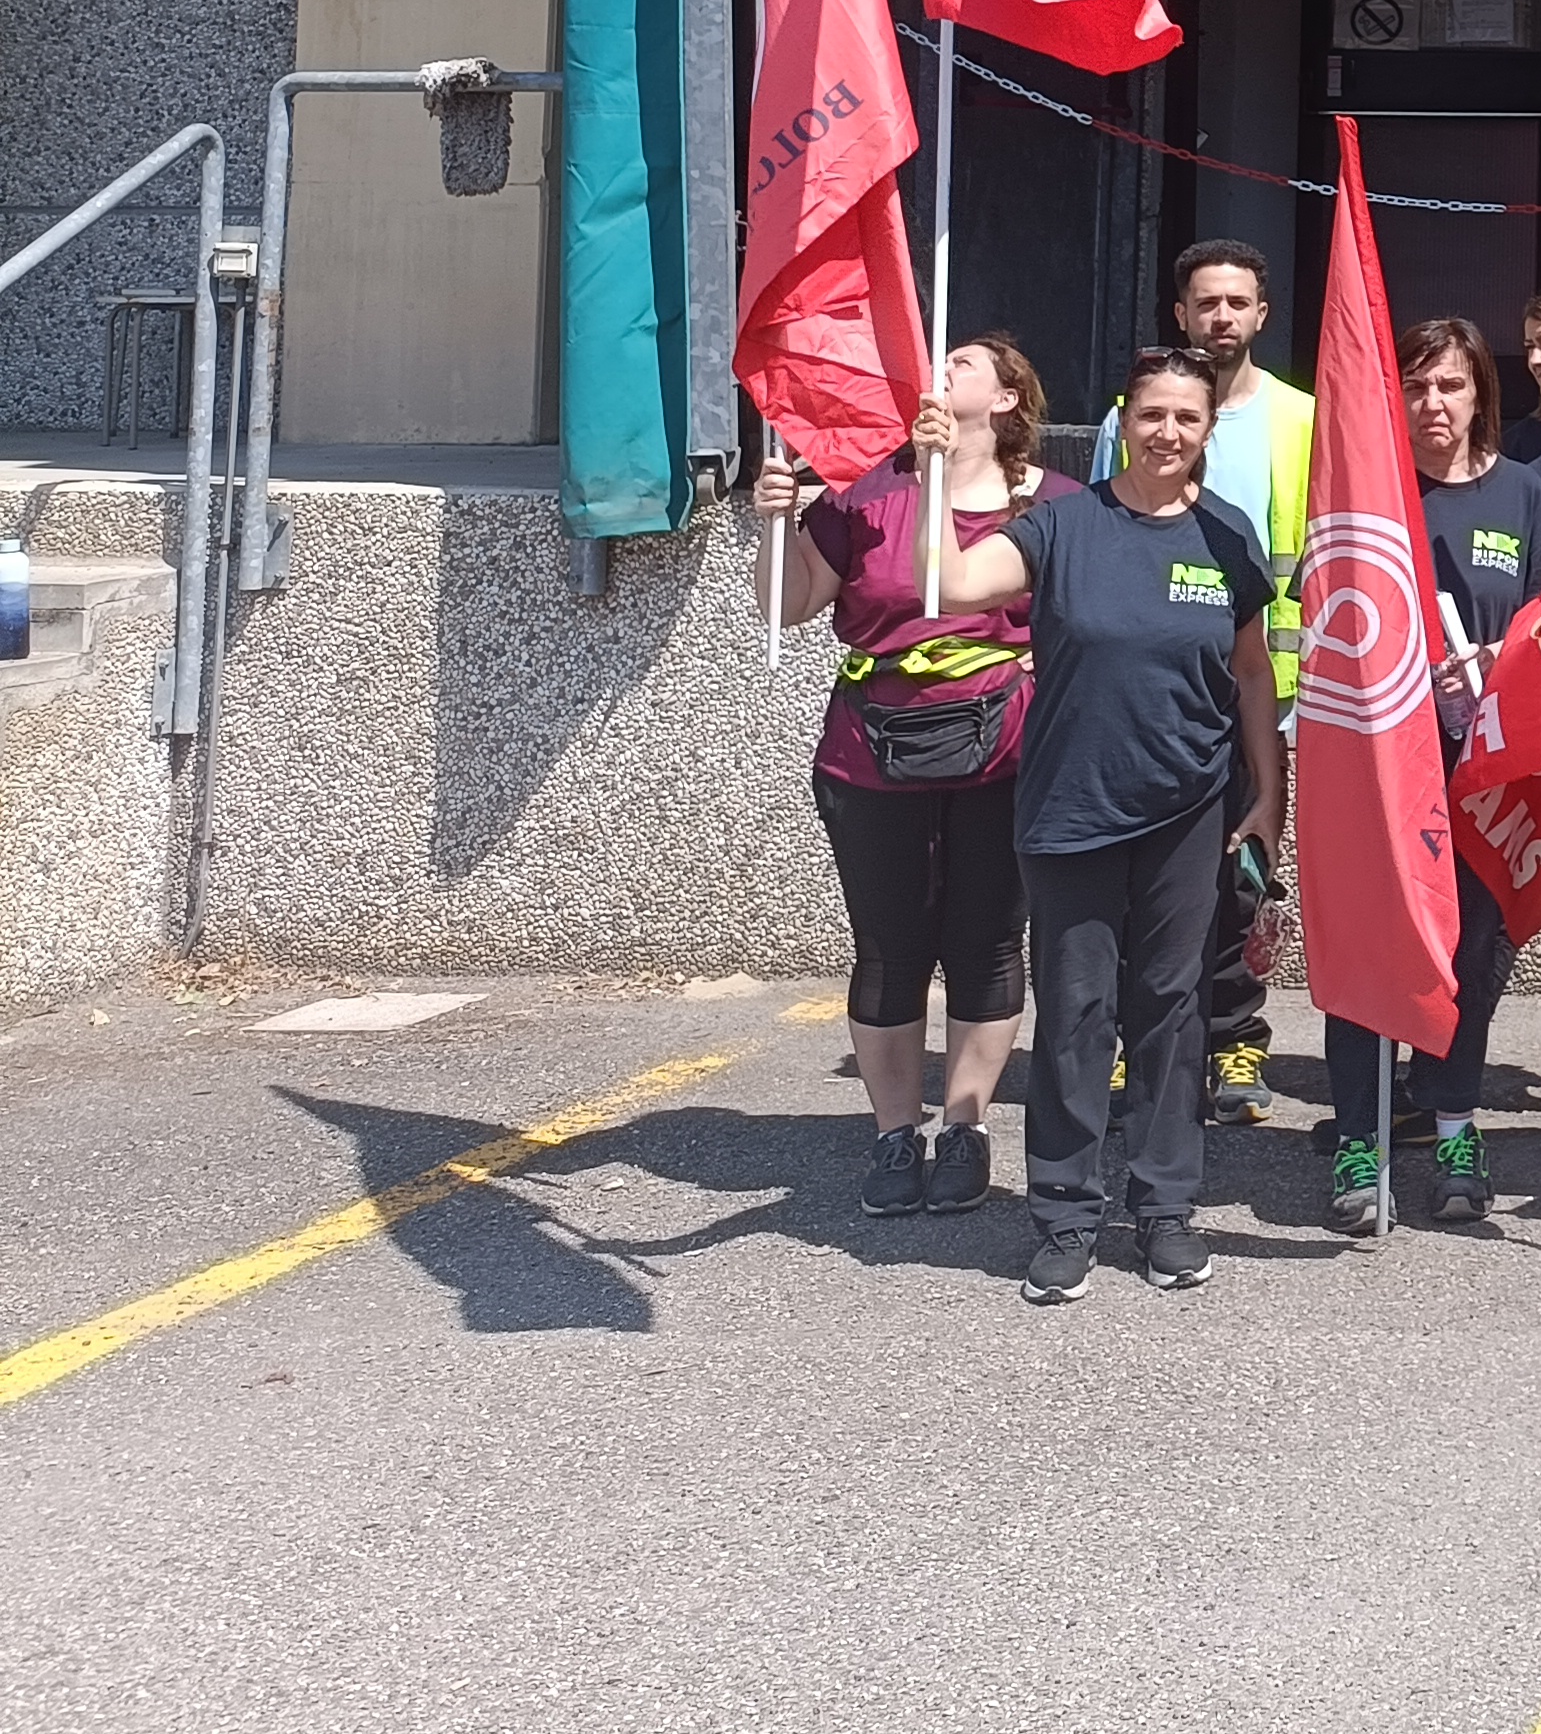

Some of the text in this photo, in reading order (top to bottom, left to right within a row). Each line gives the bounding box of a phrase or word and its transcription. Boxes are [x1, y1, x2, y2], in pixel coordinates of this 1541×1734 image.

[1471, 556, 1518, 578] EXPRESS
[1472, 548, 1520, 570] NIPPON
[1168, 591, 1229, 606] EXPRESS
[1169, 582, 1229, 600] NIPPON
